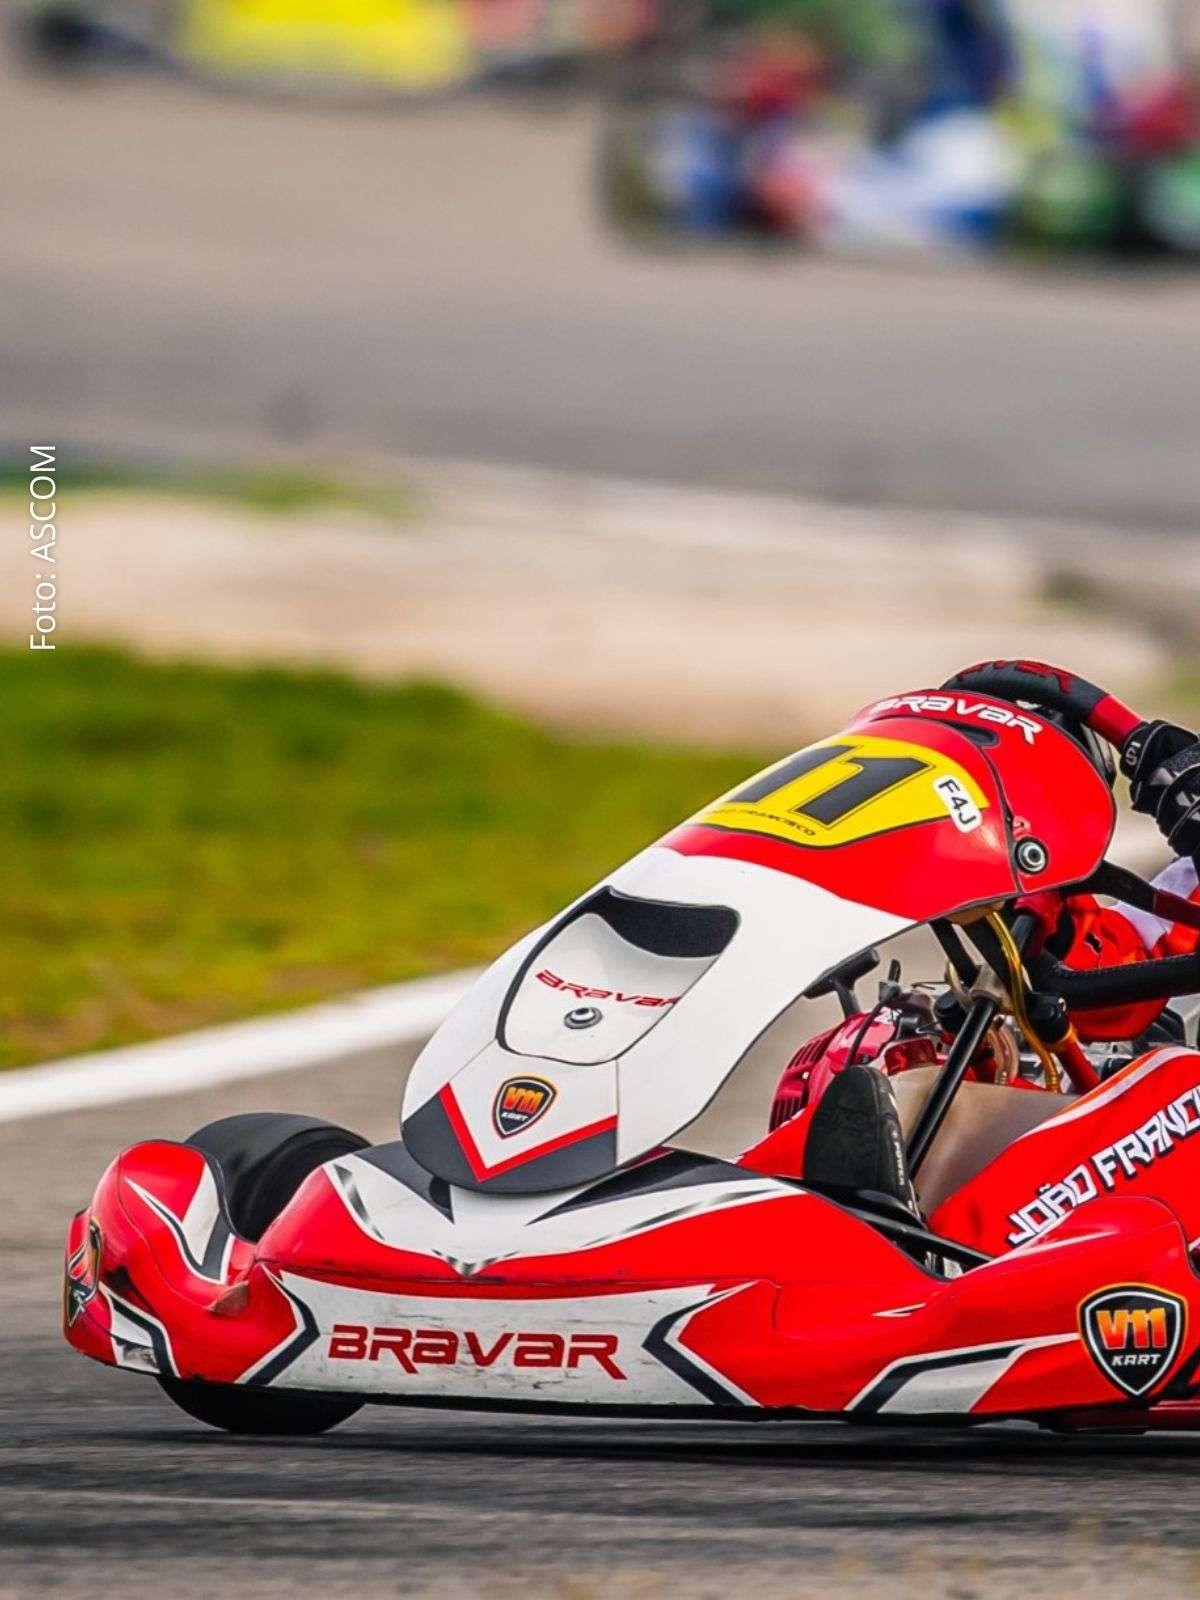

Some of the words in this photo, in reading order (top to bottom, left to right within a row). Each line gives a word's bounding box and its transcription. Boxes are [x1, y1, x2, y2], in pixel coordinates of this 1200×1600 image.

[938, 779, 977, 825] F4J
[1007, 1163, 1099, 1246] JOÃO
[1111, 1353, 1161, 1367] KART
